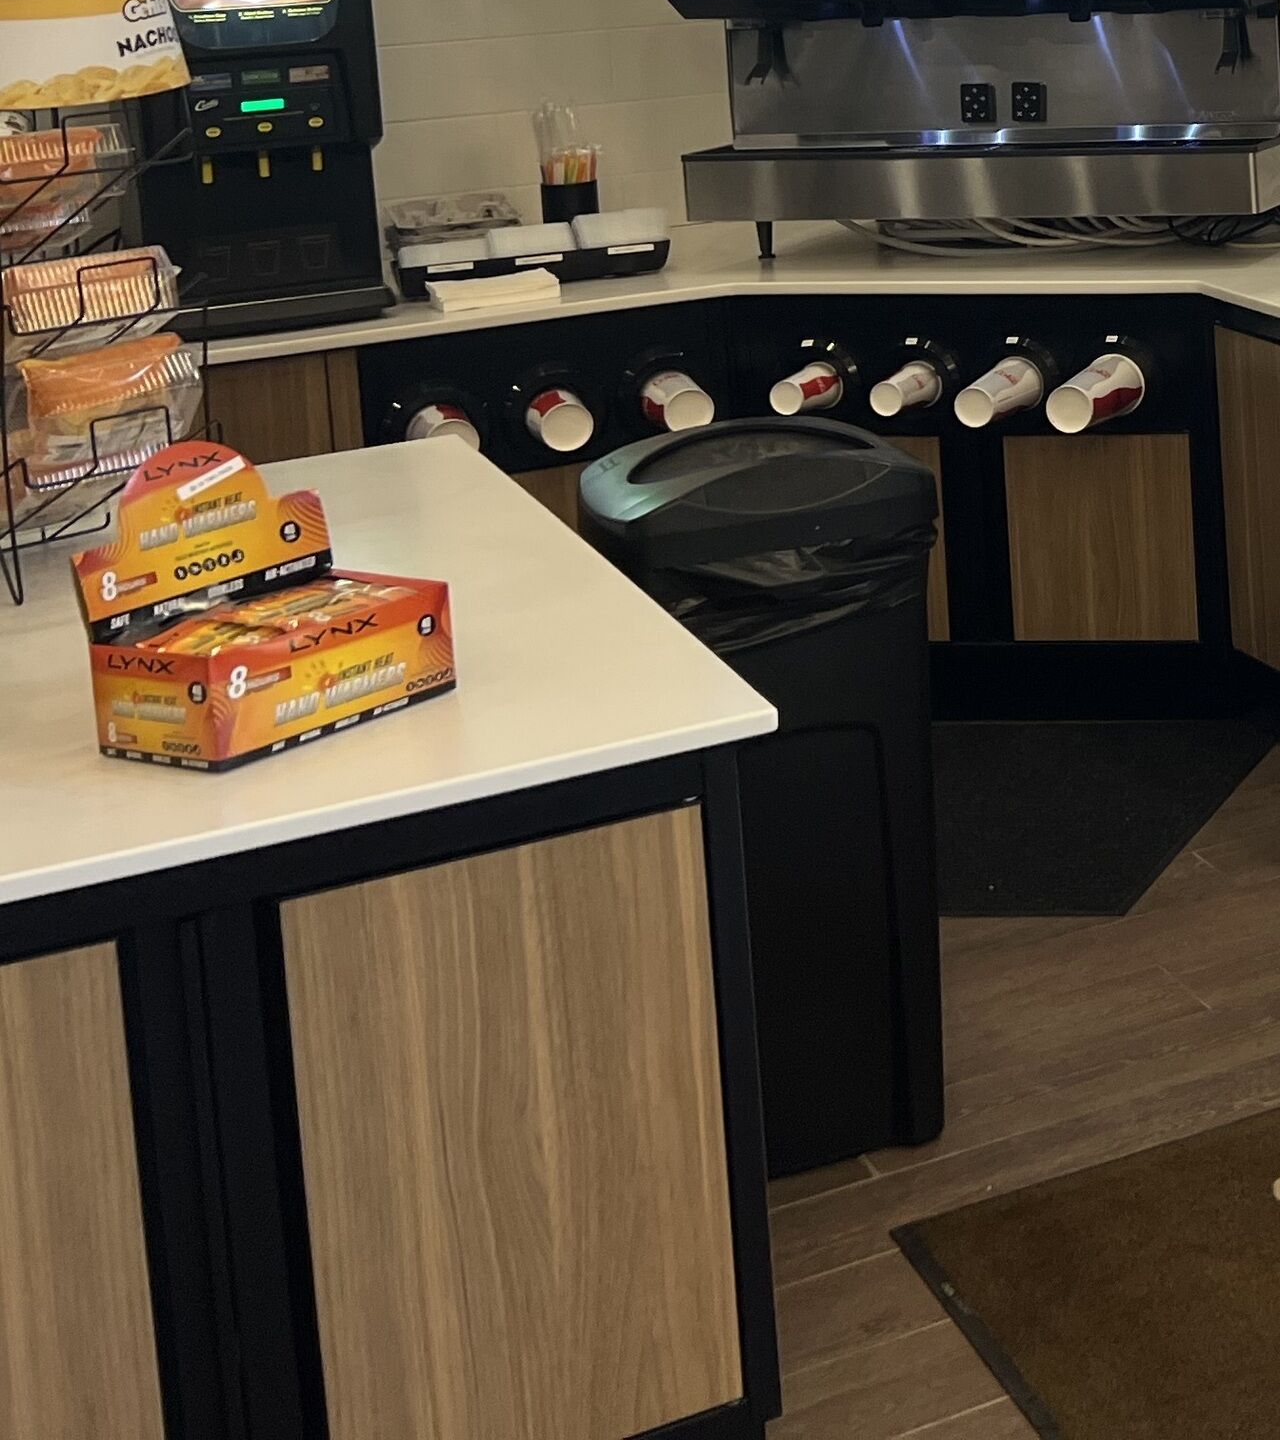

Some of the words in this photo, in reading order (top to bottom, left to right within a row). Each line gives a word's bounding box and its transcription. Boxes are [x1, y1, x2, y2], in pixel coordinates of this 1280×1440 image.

[144, 451, 223, 482] LYNX
[140, 523, 179, 551] HAND
[183, 500, 257, 539] WARMERS
[102, 571, 118, 601] 8
[289, 613, 379, 653] LYNX
[107, 654, 176, 675] LYNX
[227, 665, 248, 700] 8
[275, 691, 320, 726] HAND
[325, 662, 407, 709] WARMERS
